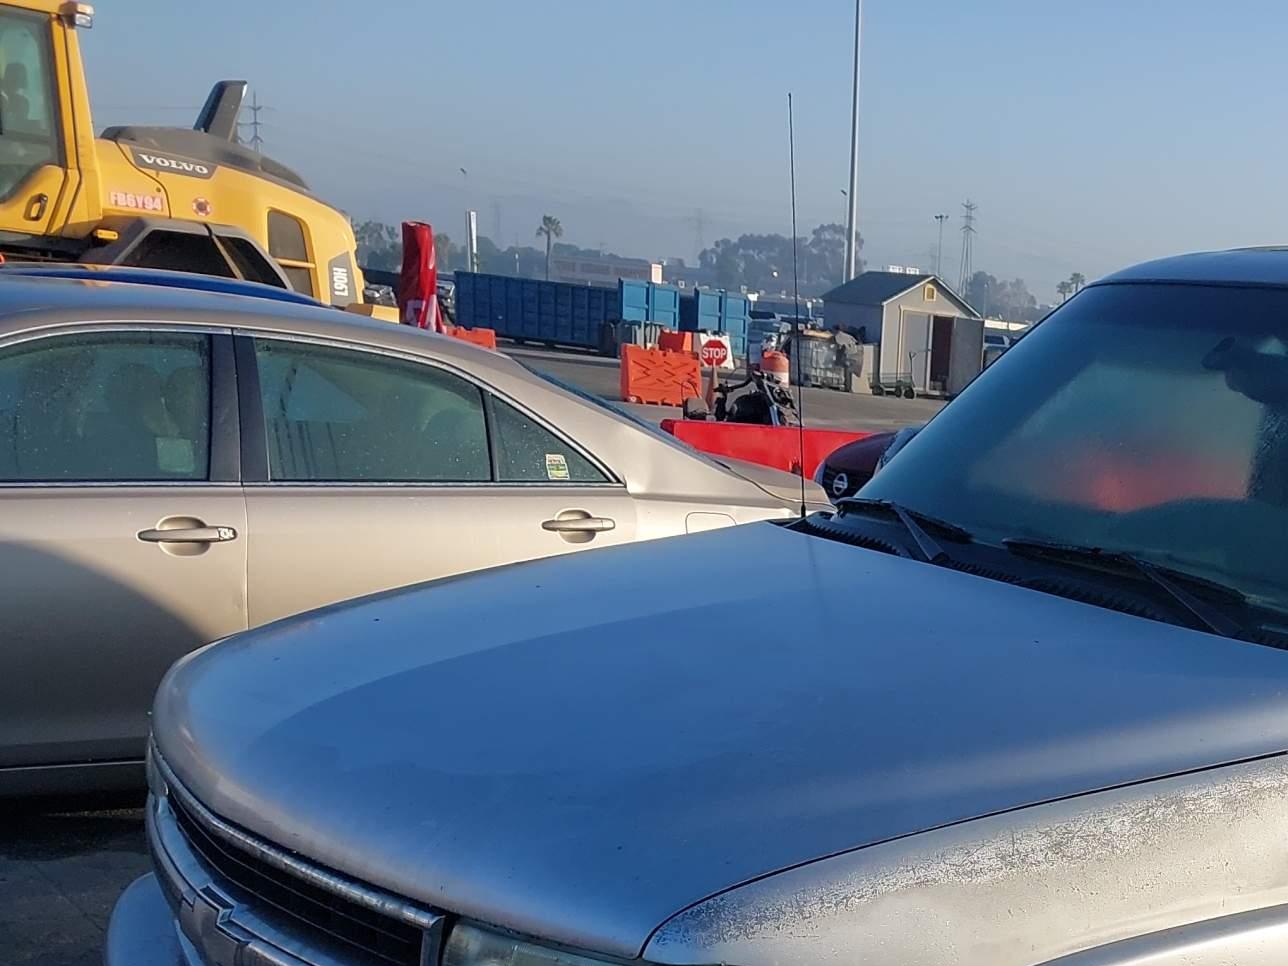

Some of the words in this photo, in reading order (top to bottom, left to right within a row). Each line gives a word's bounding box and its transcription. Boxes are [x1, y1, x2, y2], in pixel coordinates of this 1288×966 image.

[138, 153, 209, 174] VOLVO
[332, 266, 348, 297] L90H
[702, 347, 727, 359] STOP
